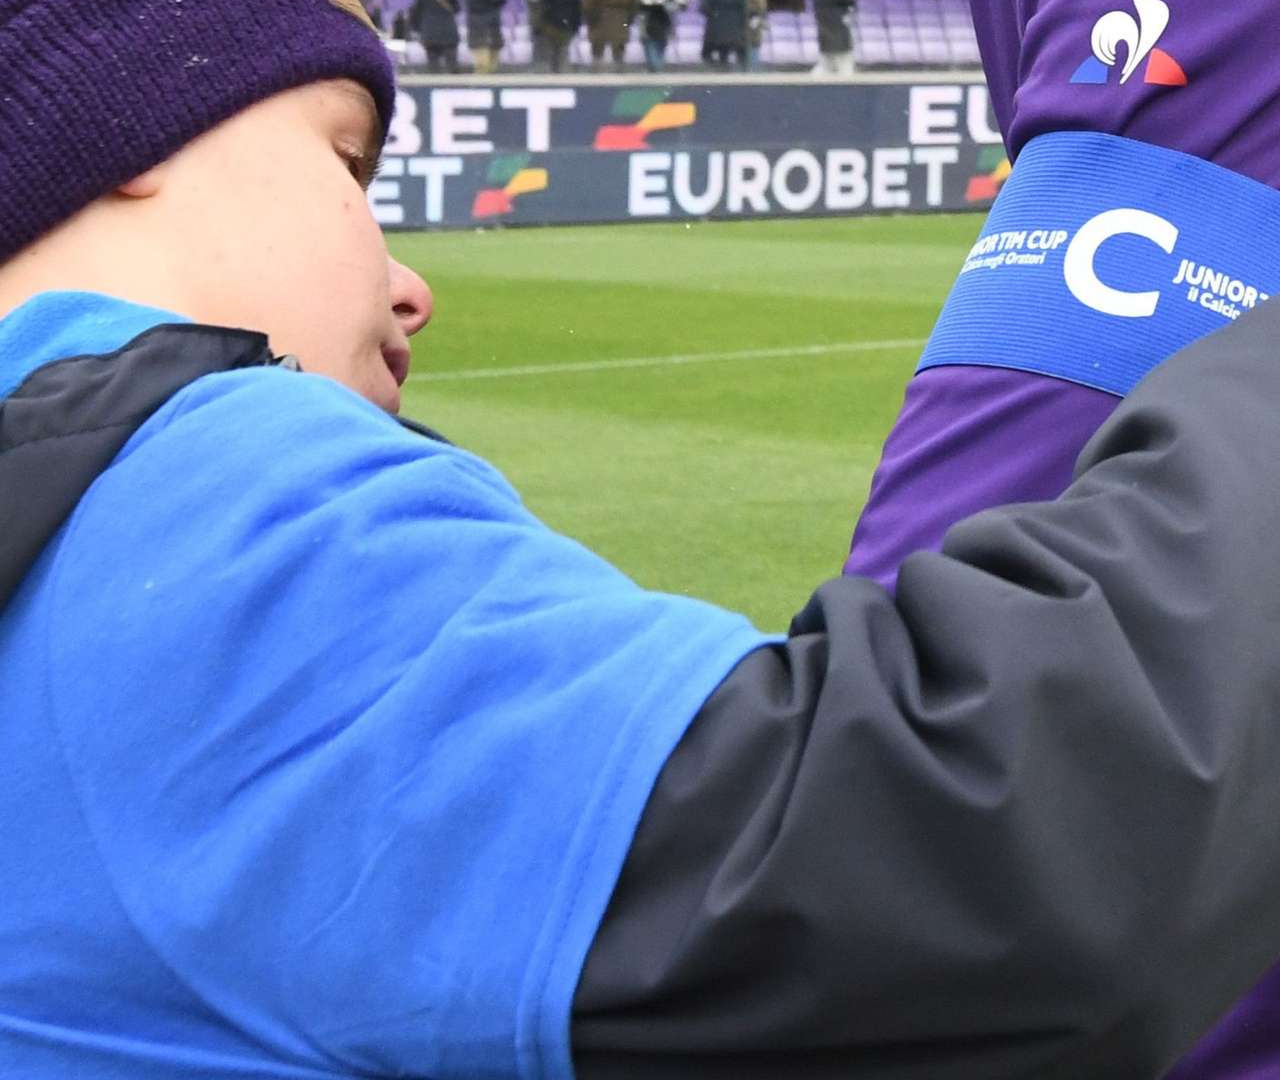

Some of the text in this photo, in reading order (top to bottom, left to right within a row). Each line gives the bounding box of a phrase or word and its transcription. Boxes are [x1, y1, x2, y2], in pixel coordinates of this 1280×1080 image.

[628, 147, 959, 217] EUROBET
[998, 230, 1028, 250] TIM
[1027, 230, 1068, 250] CUP
[1004, 251, 1047, 265] Oratori
[1063, 207, 1180, 317] C
[1172, 258, 1258, 309] JUNIOR
